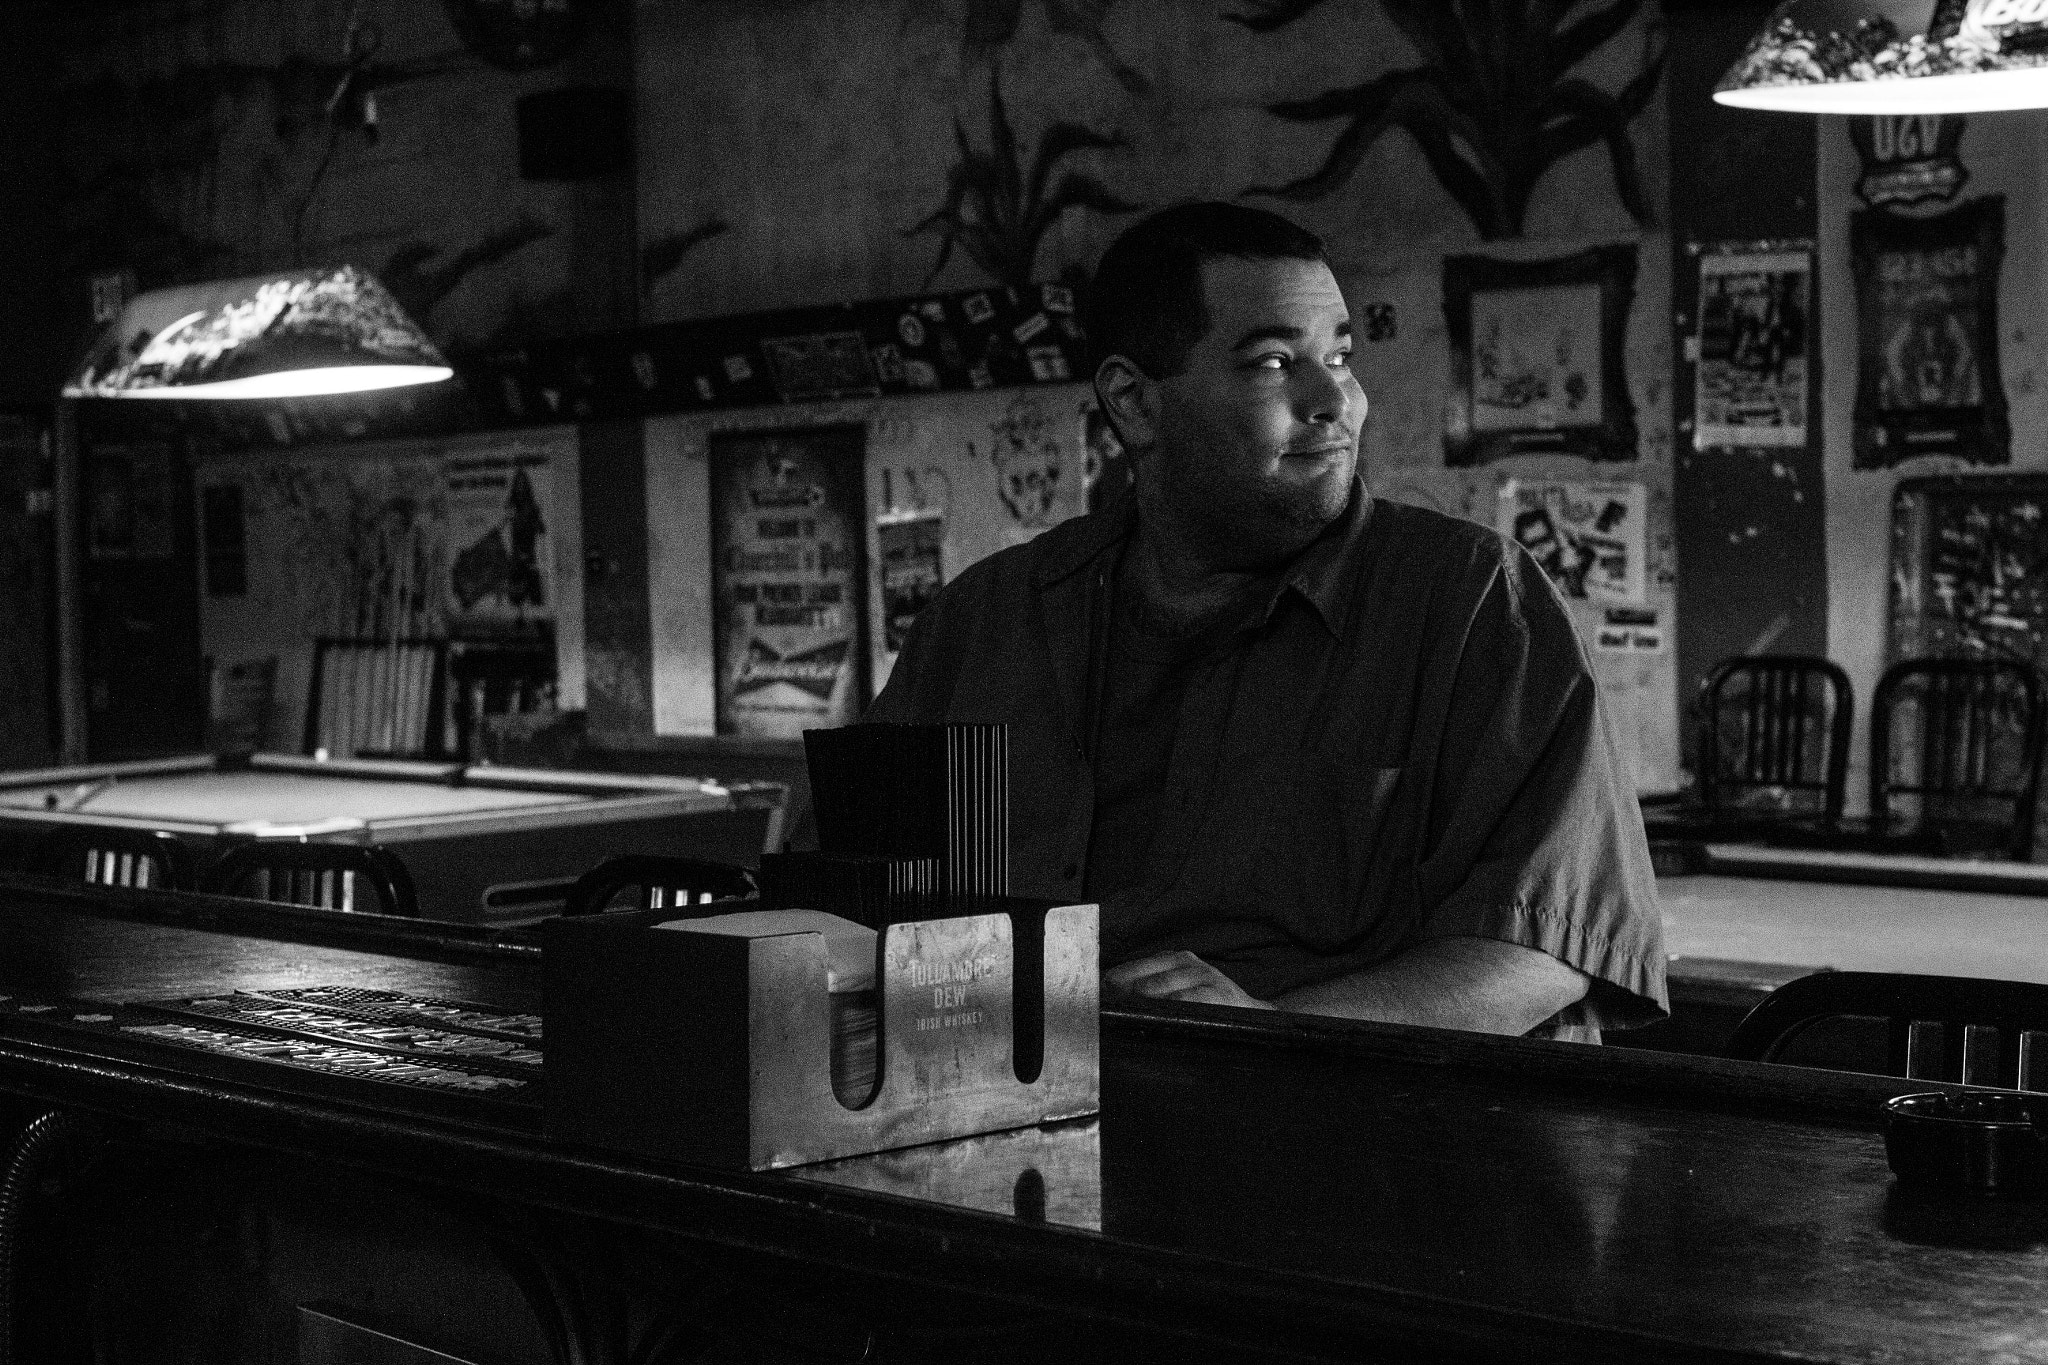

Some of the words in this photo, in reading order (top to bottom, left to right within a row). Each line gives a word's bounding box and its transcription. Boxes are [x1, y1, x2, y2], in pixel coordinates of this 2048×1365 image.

[908, 957, 993, 988] TULLAMORE
[934, 985, 966, 1009] DEW
[917, 1017, 941, 1031] IRISH
[944, 1011, 983, 1027] WHISKEY
